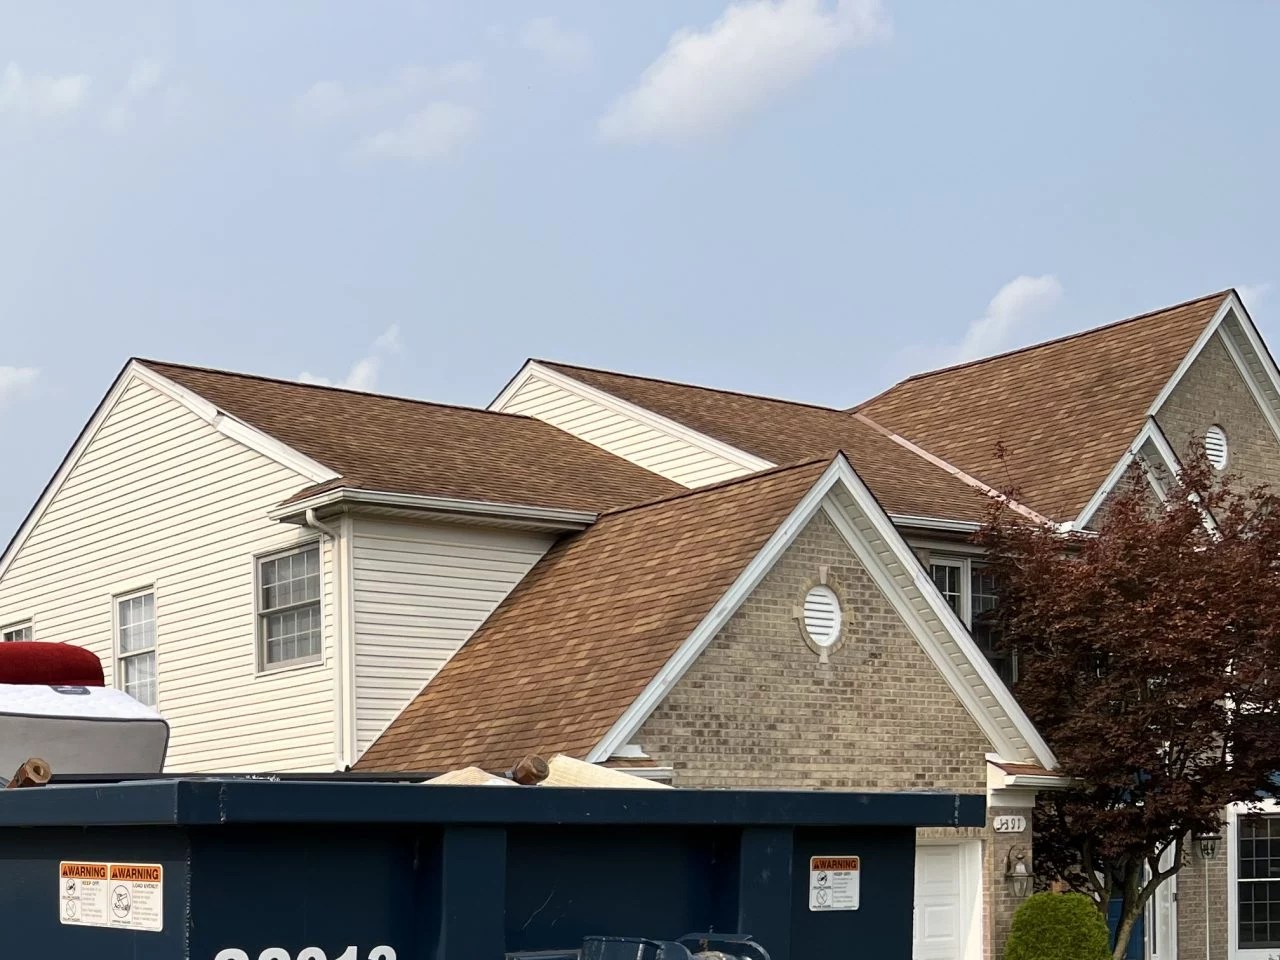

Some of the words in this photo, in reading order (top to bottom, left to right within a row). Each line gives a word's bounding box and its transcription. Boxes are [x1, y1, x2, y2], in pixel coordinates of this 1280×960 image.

[819, 860, 857, 869] WARNING
[67, 865, 106, 878] WARNING
[119, 867, 159, 880] WARNING
